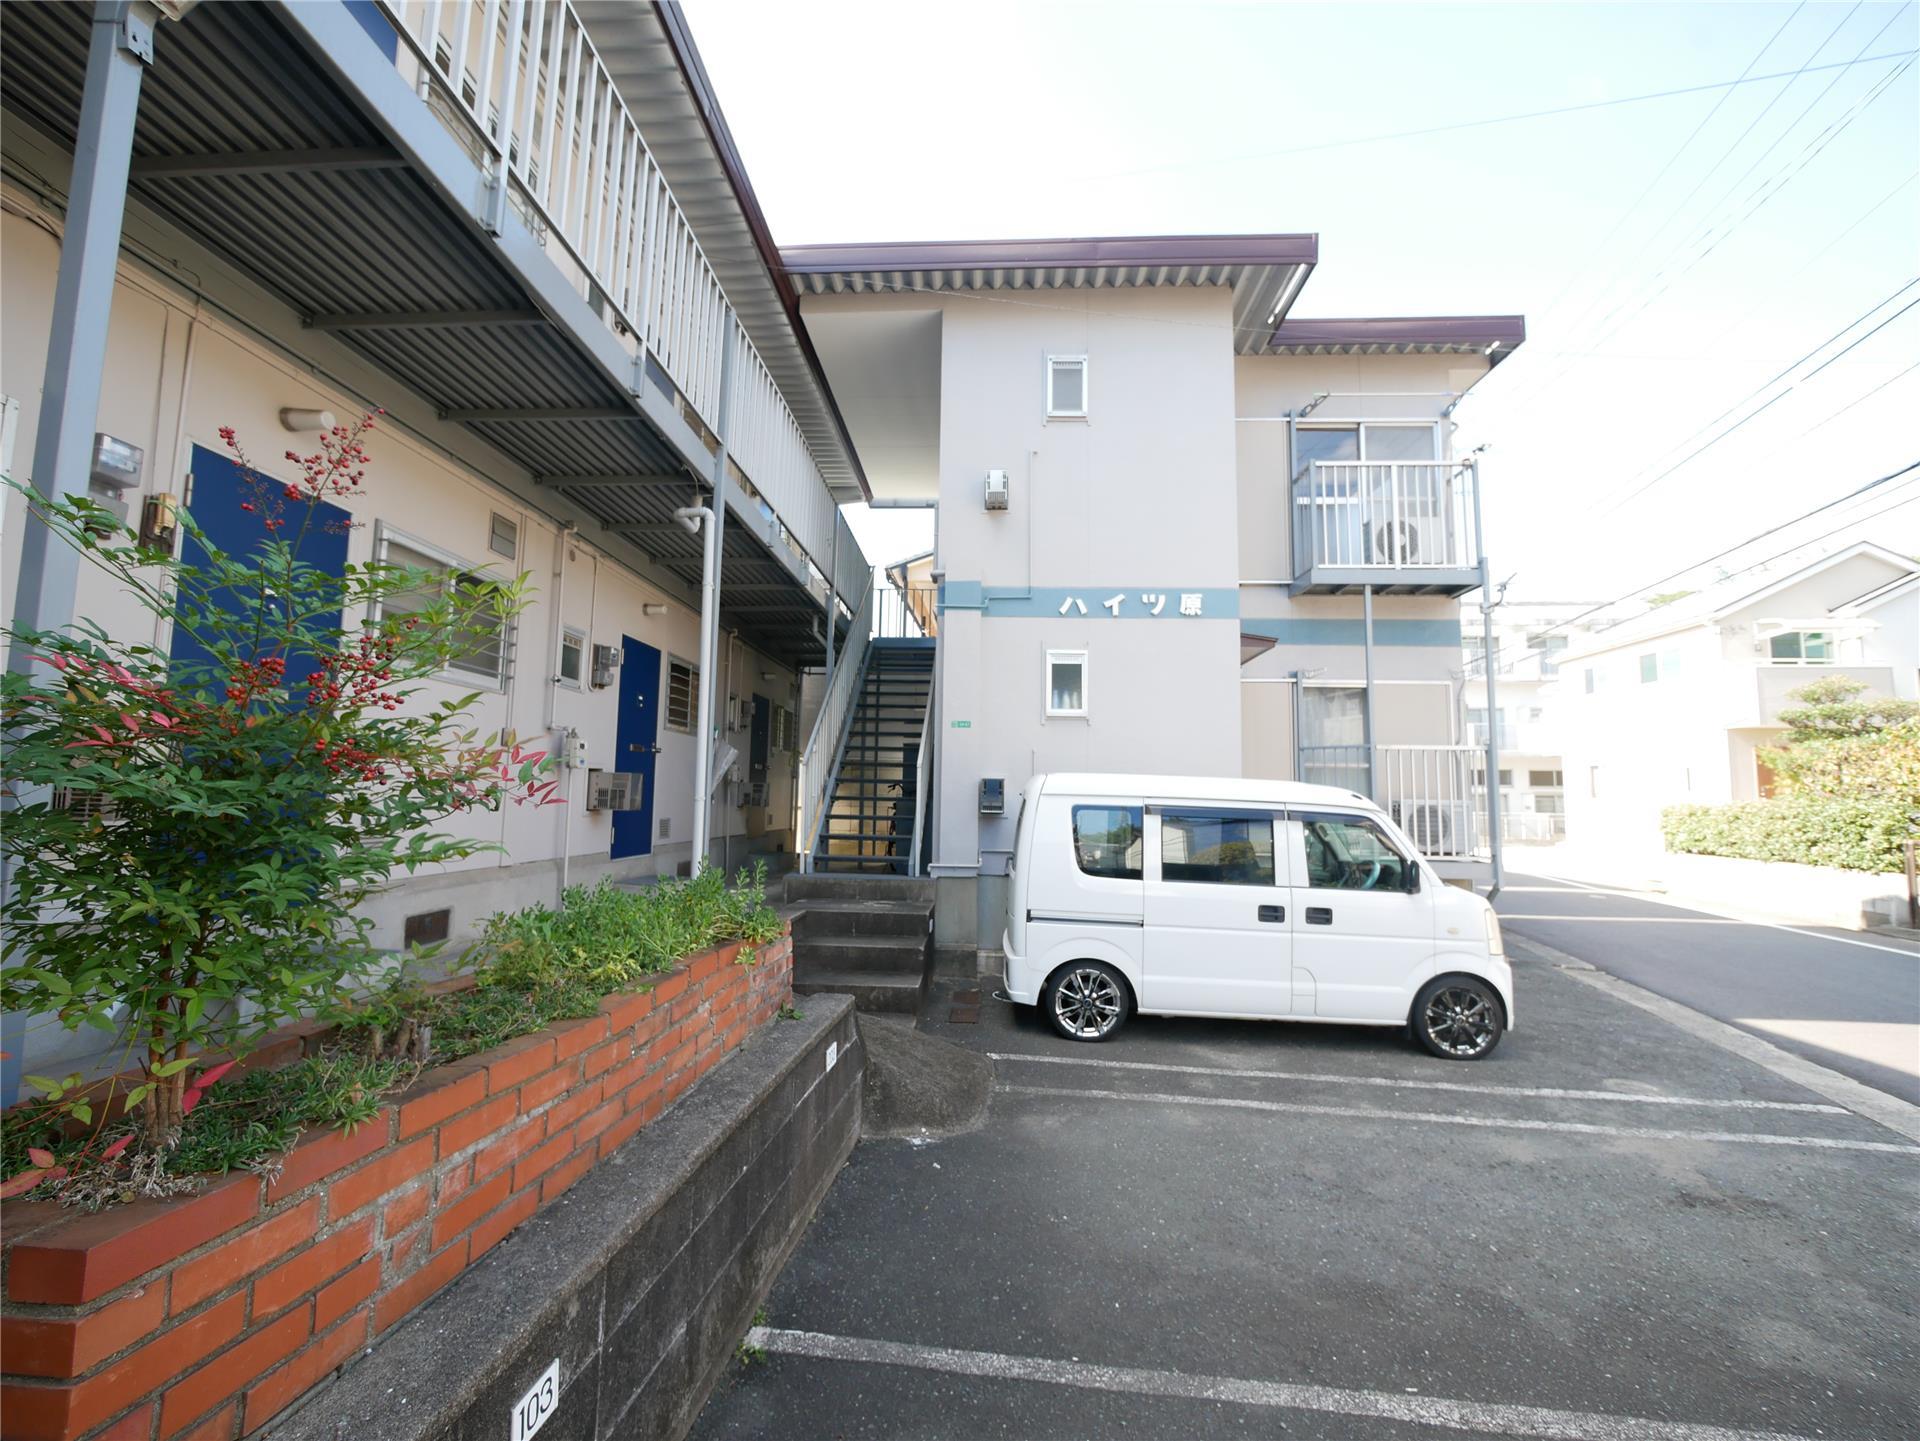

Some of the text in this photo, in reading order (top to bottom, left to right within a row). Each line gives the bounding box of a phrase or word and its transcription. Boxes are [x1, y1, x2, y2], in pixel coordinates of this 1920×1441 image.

[1058, 593, 1203, 617] ハイツ原
[519, 1376, 553, 1441] 103
